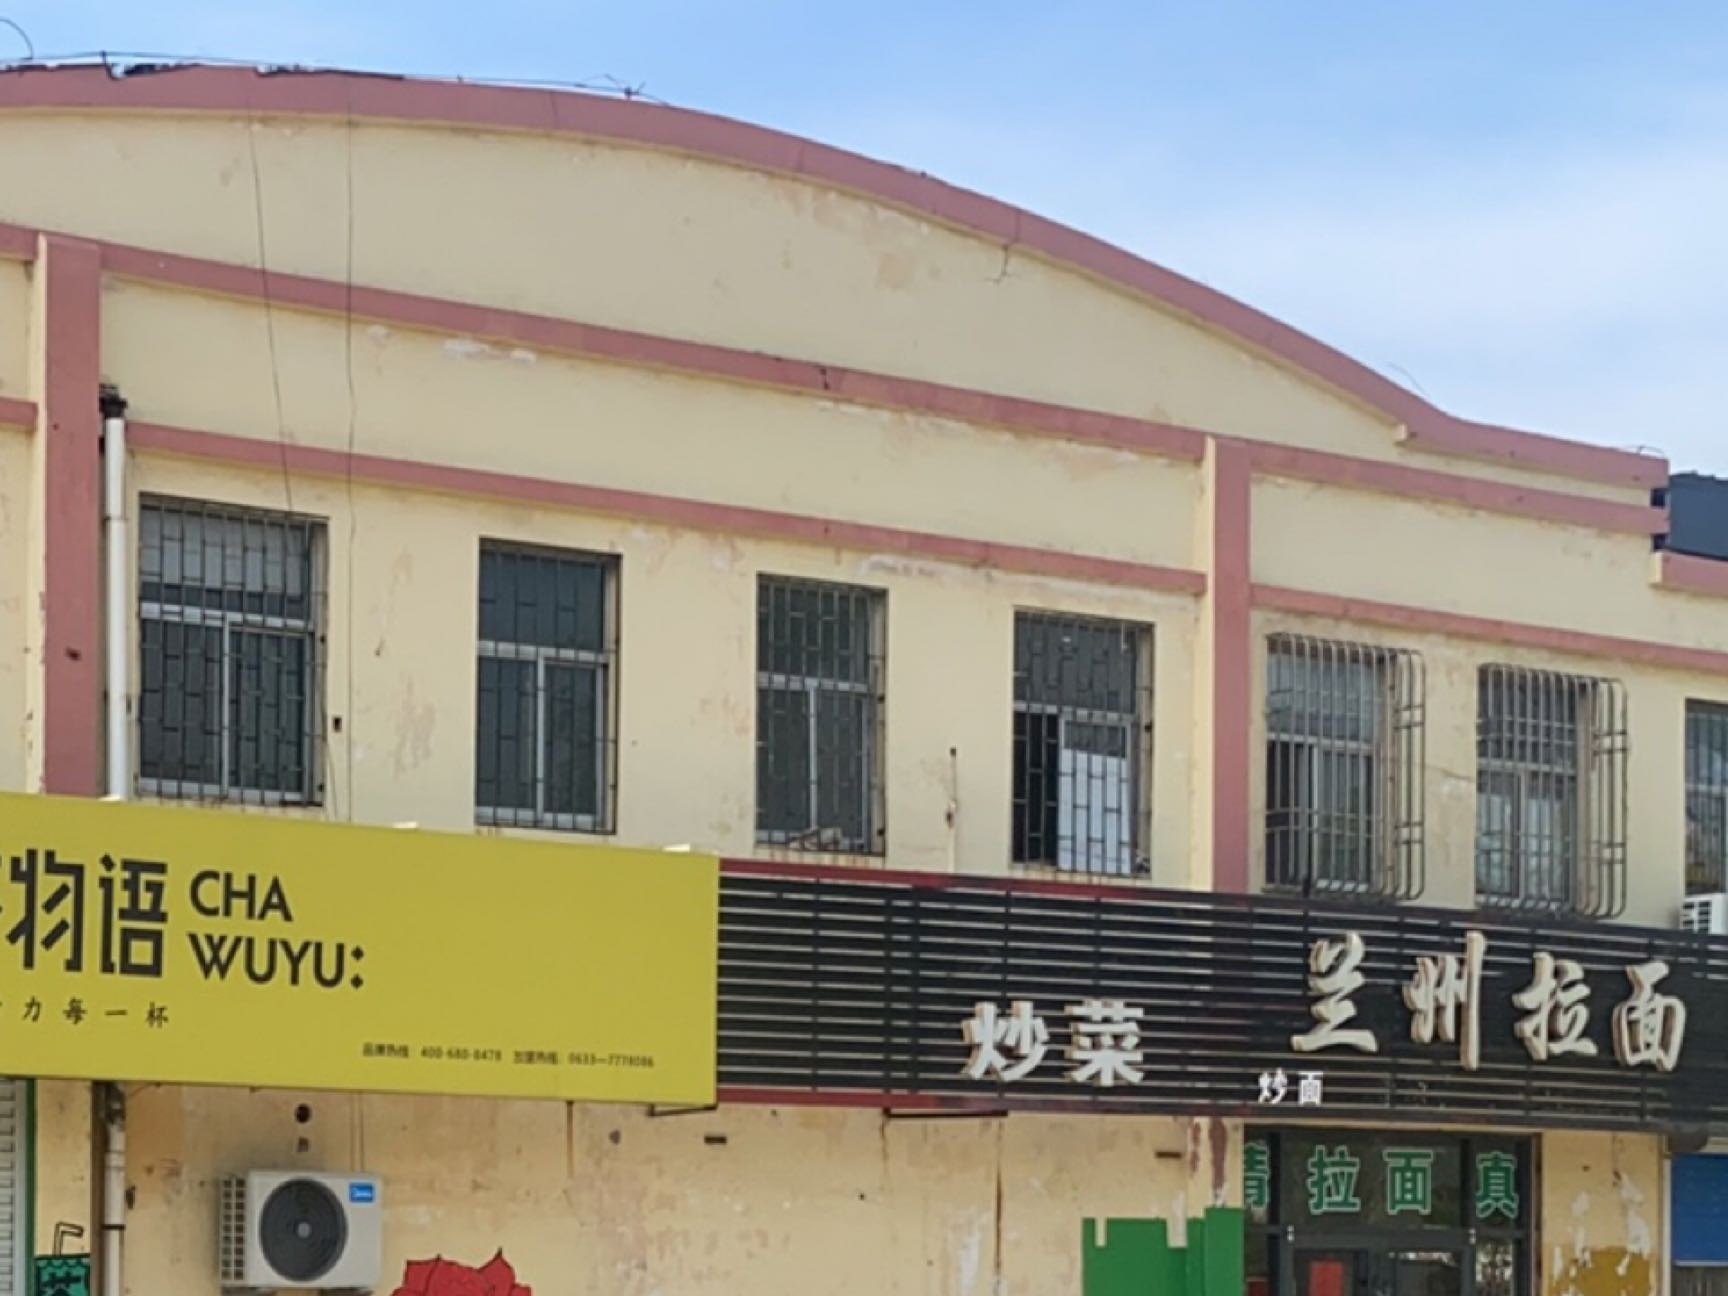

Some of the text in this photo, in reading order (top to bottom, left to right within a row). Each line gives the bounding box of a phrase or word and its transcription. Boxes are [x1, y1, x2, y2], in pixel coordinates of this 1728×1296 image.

[189, 870, 293, 922] CHA
[1291, 930, 1686, 1072] 兰州拉面
[962, 1000, 1145, 1087] 炒菜
[1258, 1068, 1324, 1107] 炒面
